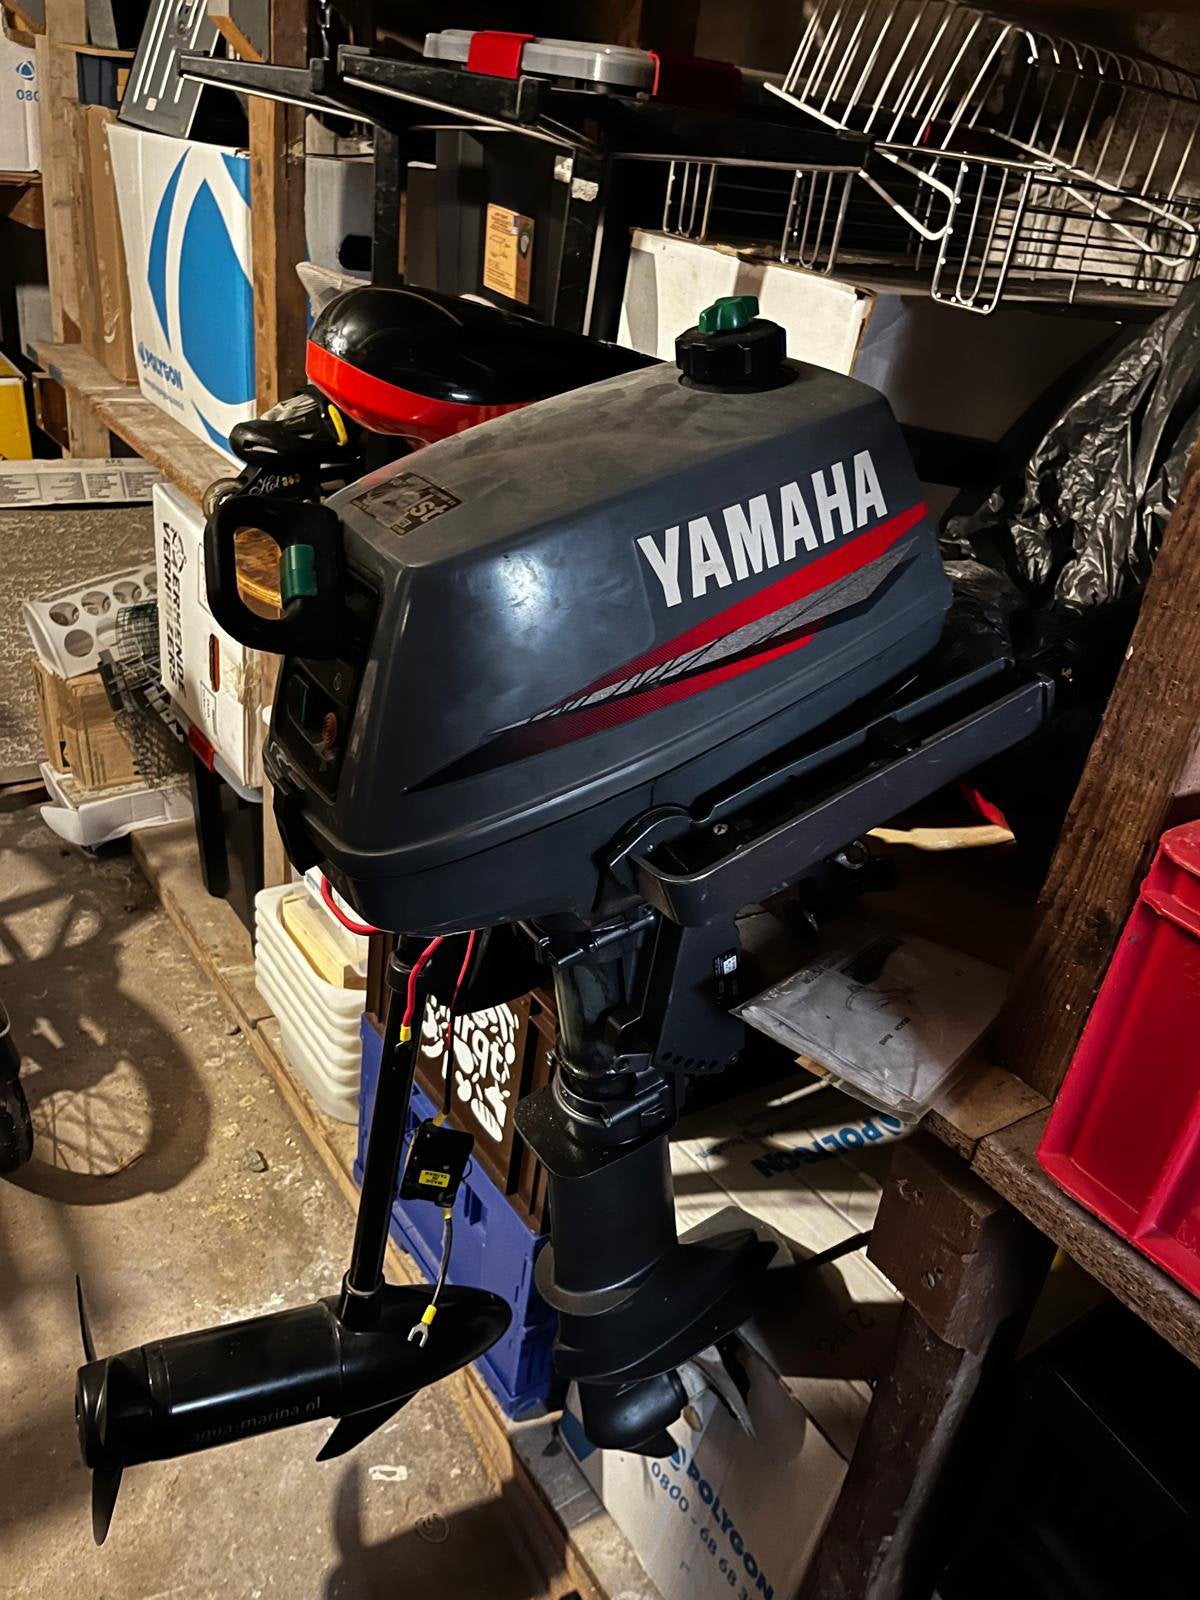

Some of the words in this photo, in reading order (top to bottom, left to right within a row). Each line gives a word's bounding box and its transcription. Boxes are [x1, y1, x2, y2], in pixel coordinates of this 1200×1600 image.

[637, 450, 888, 607] YAMAHA
[651, 1462, 689, 1512] 0800
[700, 1527, 718, 1556] 68
[686, 1459, 775, 1600] POLYGON
